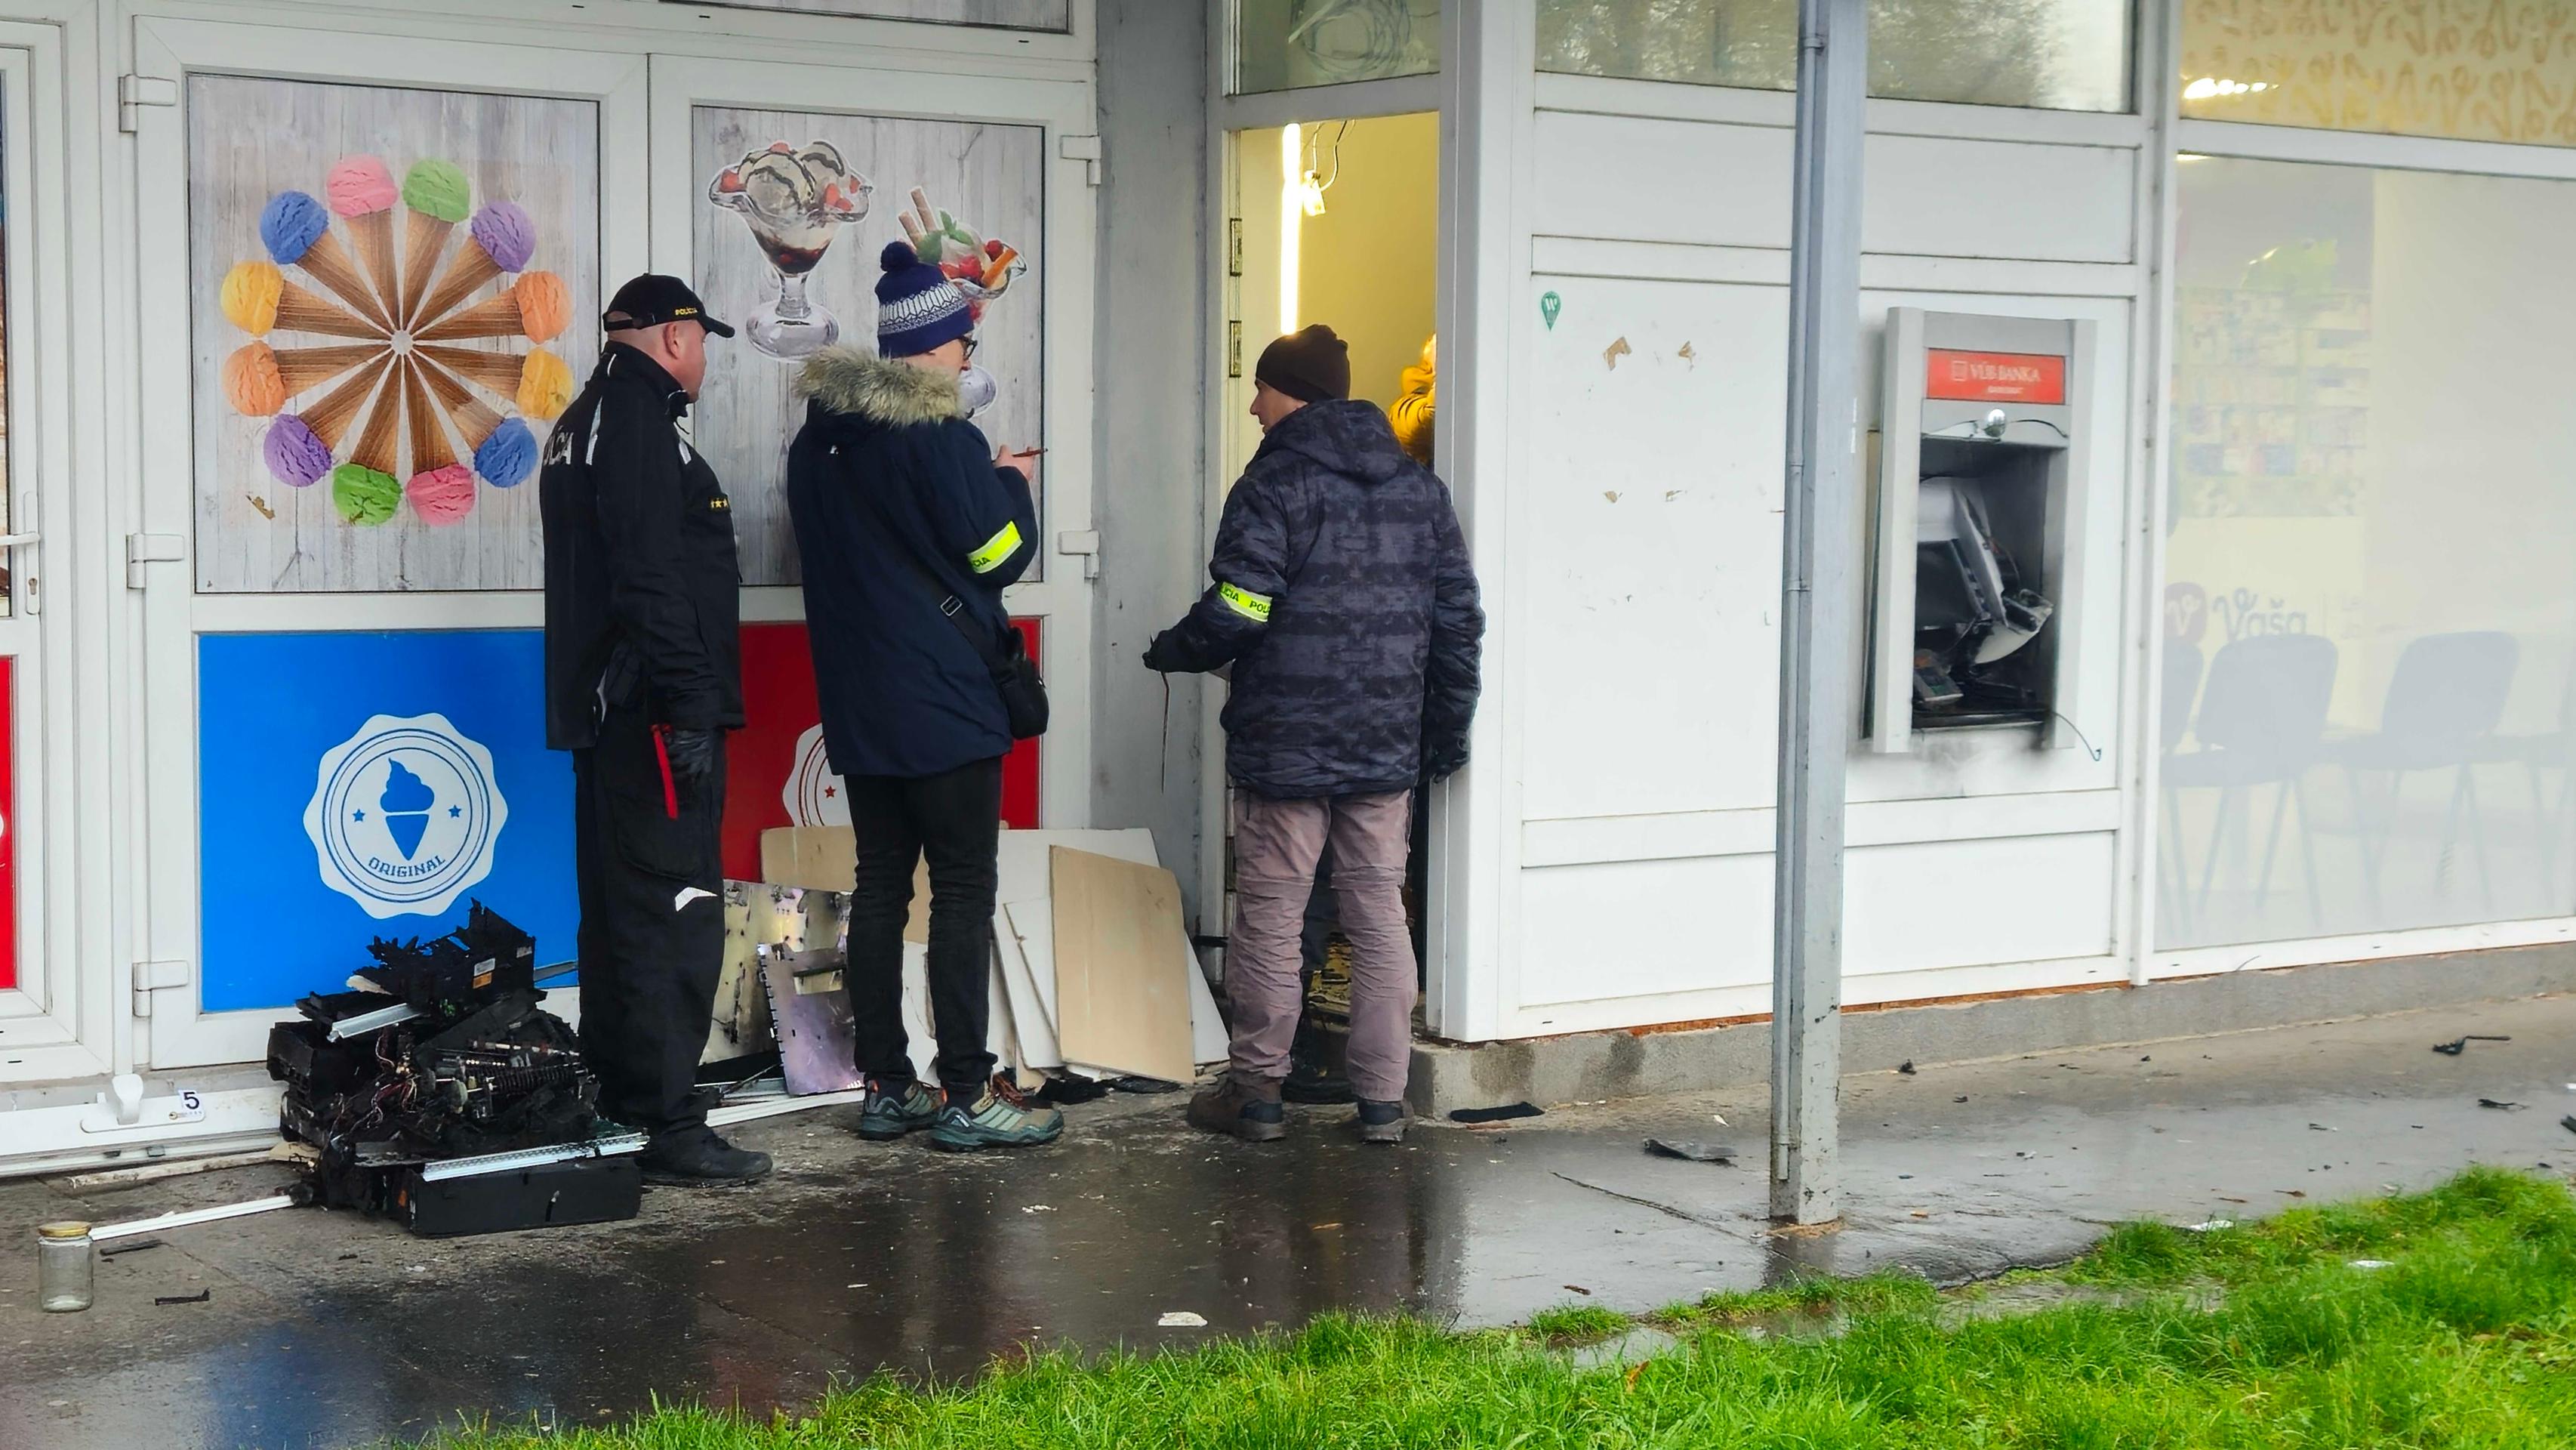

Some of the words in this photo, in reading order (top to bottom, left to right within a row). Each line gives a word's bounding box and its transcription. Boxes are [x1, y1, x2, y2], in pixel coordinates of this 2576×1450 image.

[1970, 361, 1998, 380] VÚB
[1998, 365, 2041, 382] BANKA
[2212, 587, 2307, 641] Vaša
[368, 855, 445, 877] ORIGINAL
[183, 1091, 200, 1110] 5
